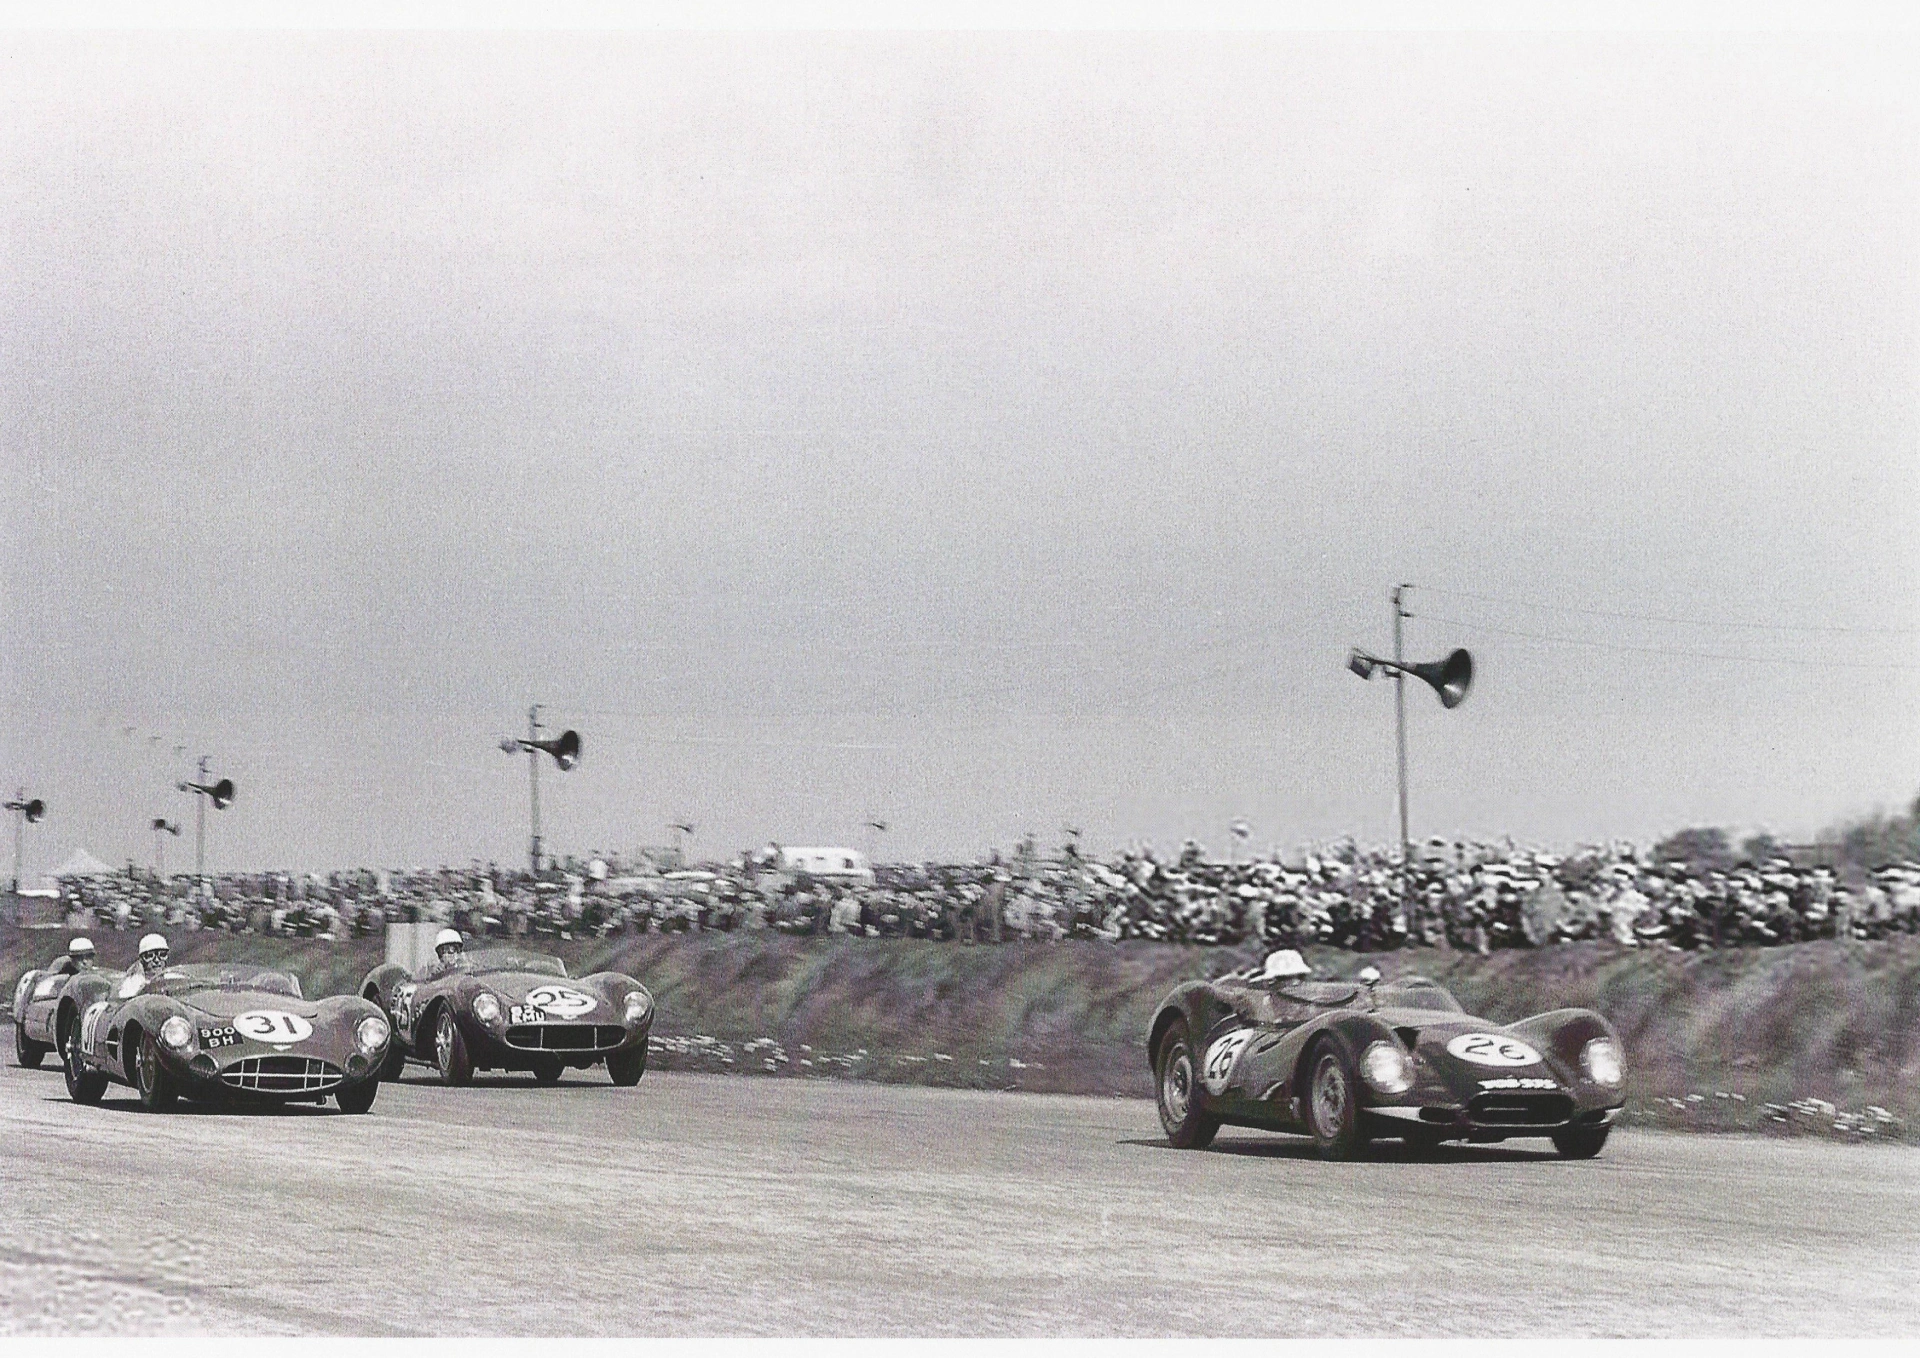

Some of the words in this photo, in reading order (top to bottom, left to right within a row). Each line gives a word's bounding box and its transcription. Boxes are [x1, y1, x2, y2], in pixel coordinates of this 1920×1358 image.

[532, 990, 588, 1007] 25
[201, 1026, 236, 1038] 900
[246, 1015, 298, 1035] 31
[209, 1036, 235, 1048] BH
[1465, 1037, 1526, 1060] 26
[1208, 1037, 1244, 1080] 26
